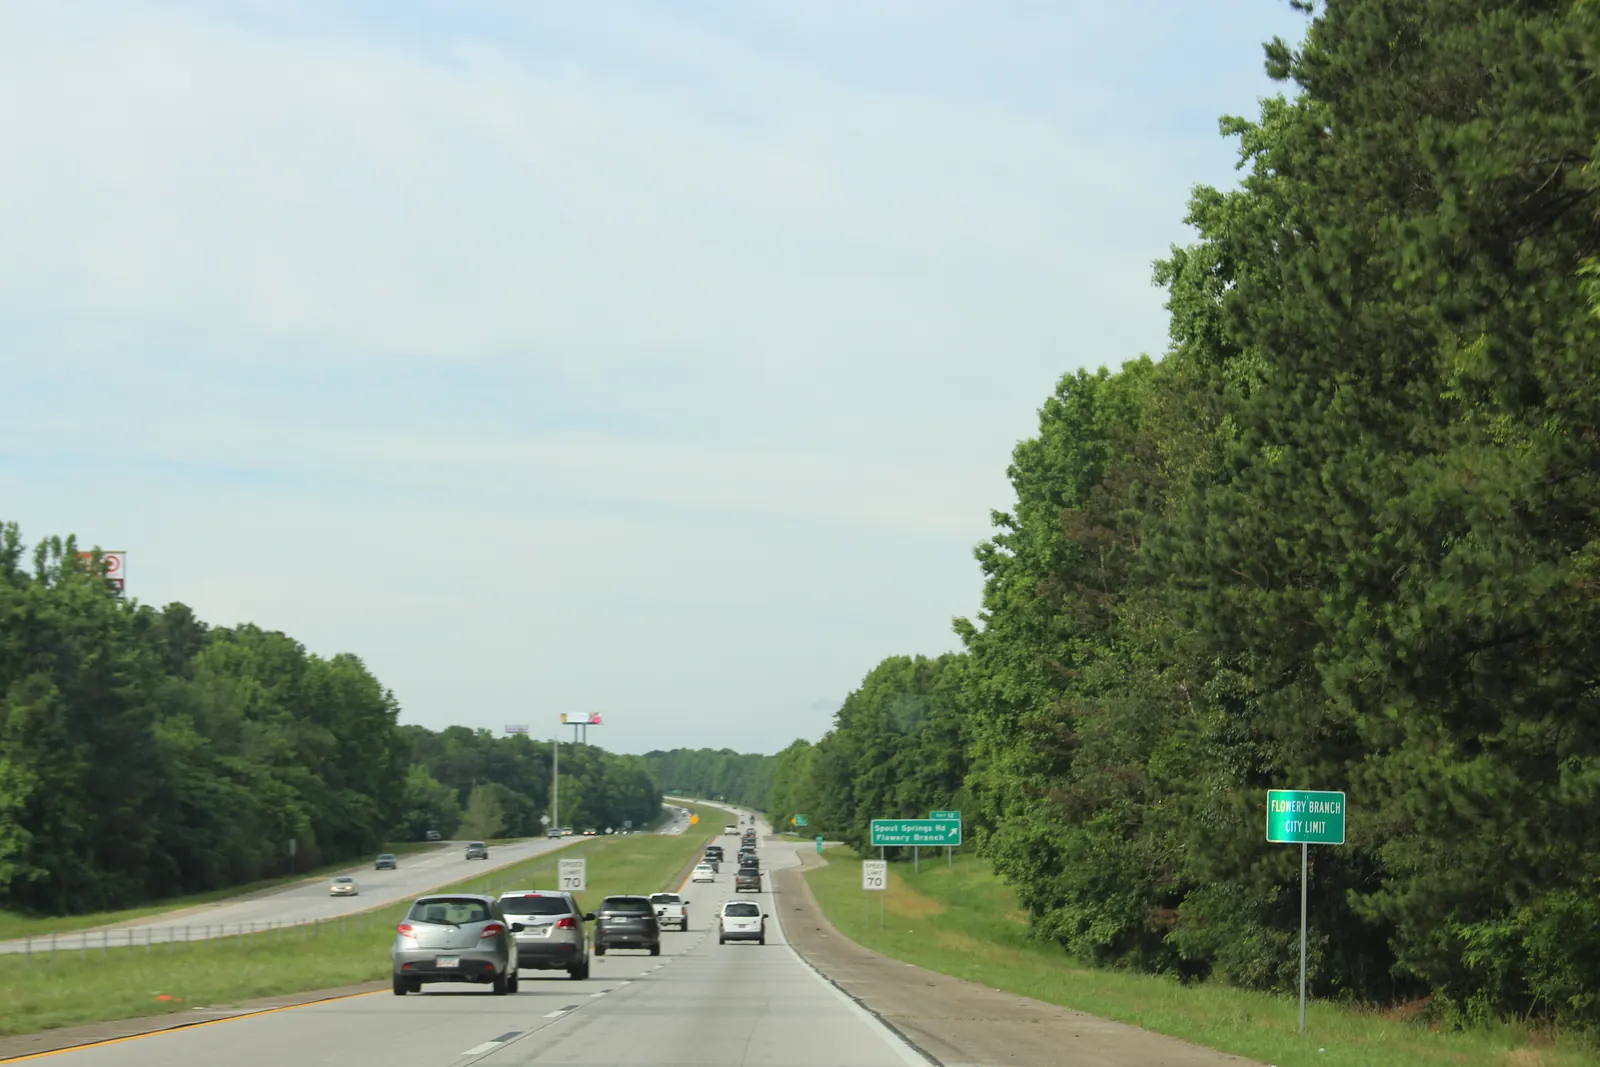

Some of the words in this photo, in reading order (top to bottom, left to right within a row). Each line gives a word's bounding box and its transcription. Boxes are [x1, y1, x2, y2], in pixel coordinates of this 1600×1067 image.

[1271, 800, 1306, 813] FLOWERY
[1309, 801, 1341, 814] BRANCH
[874, 824, 898, 833] Spout
[901, 824, 933, 833] Springs
[935, 824, 946, 832] Rd
[1285, 820, 1303, 833] CITY
[1305, 821, 1326, 834] LIMIT
[876, 834, 910, 842] Flowery
[564, 877, 581, 888] 70
[867, 877, 882, 887] 70
